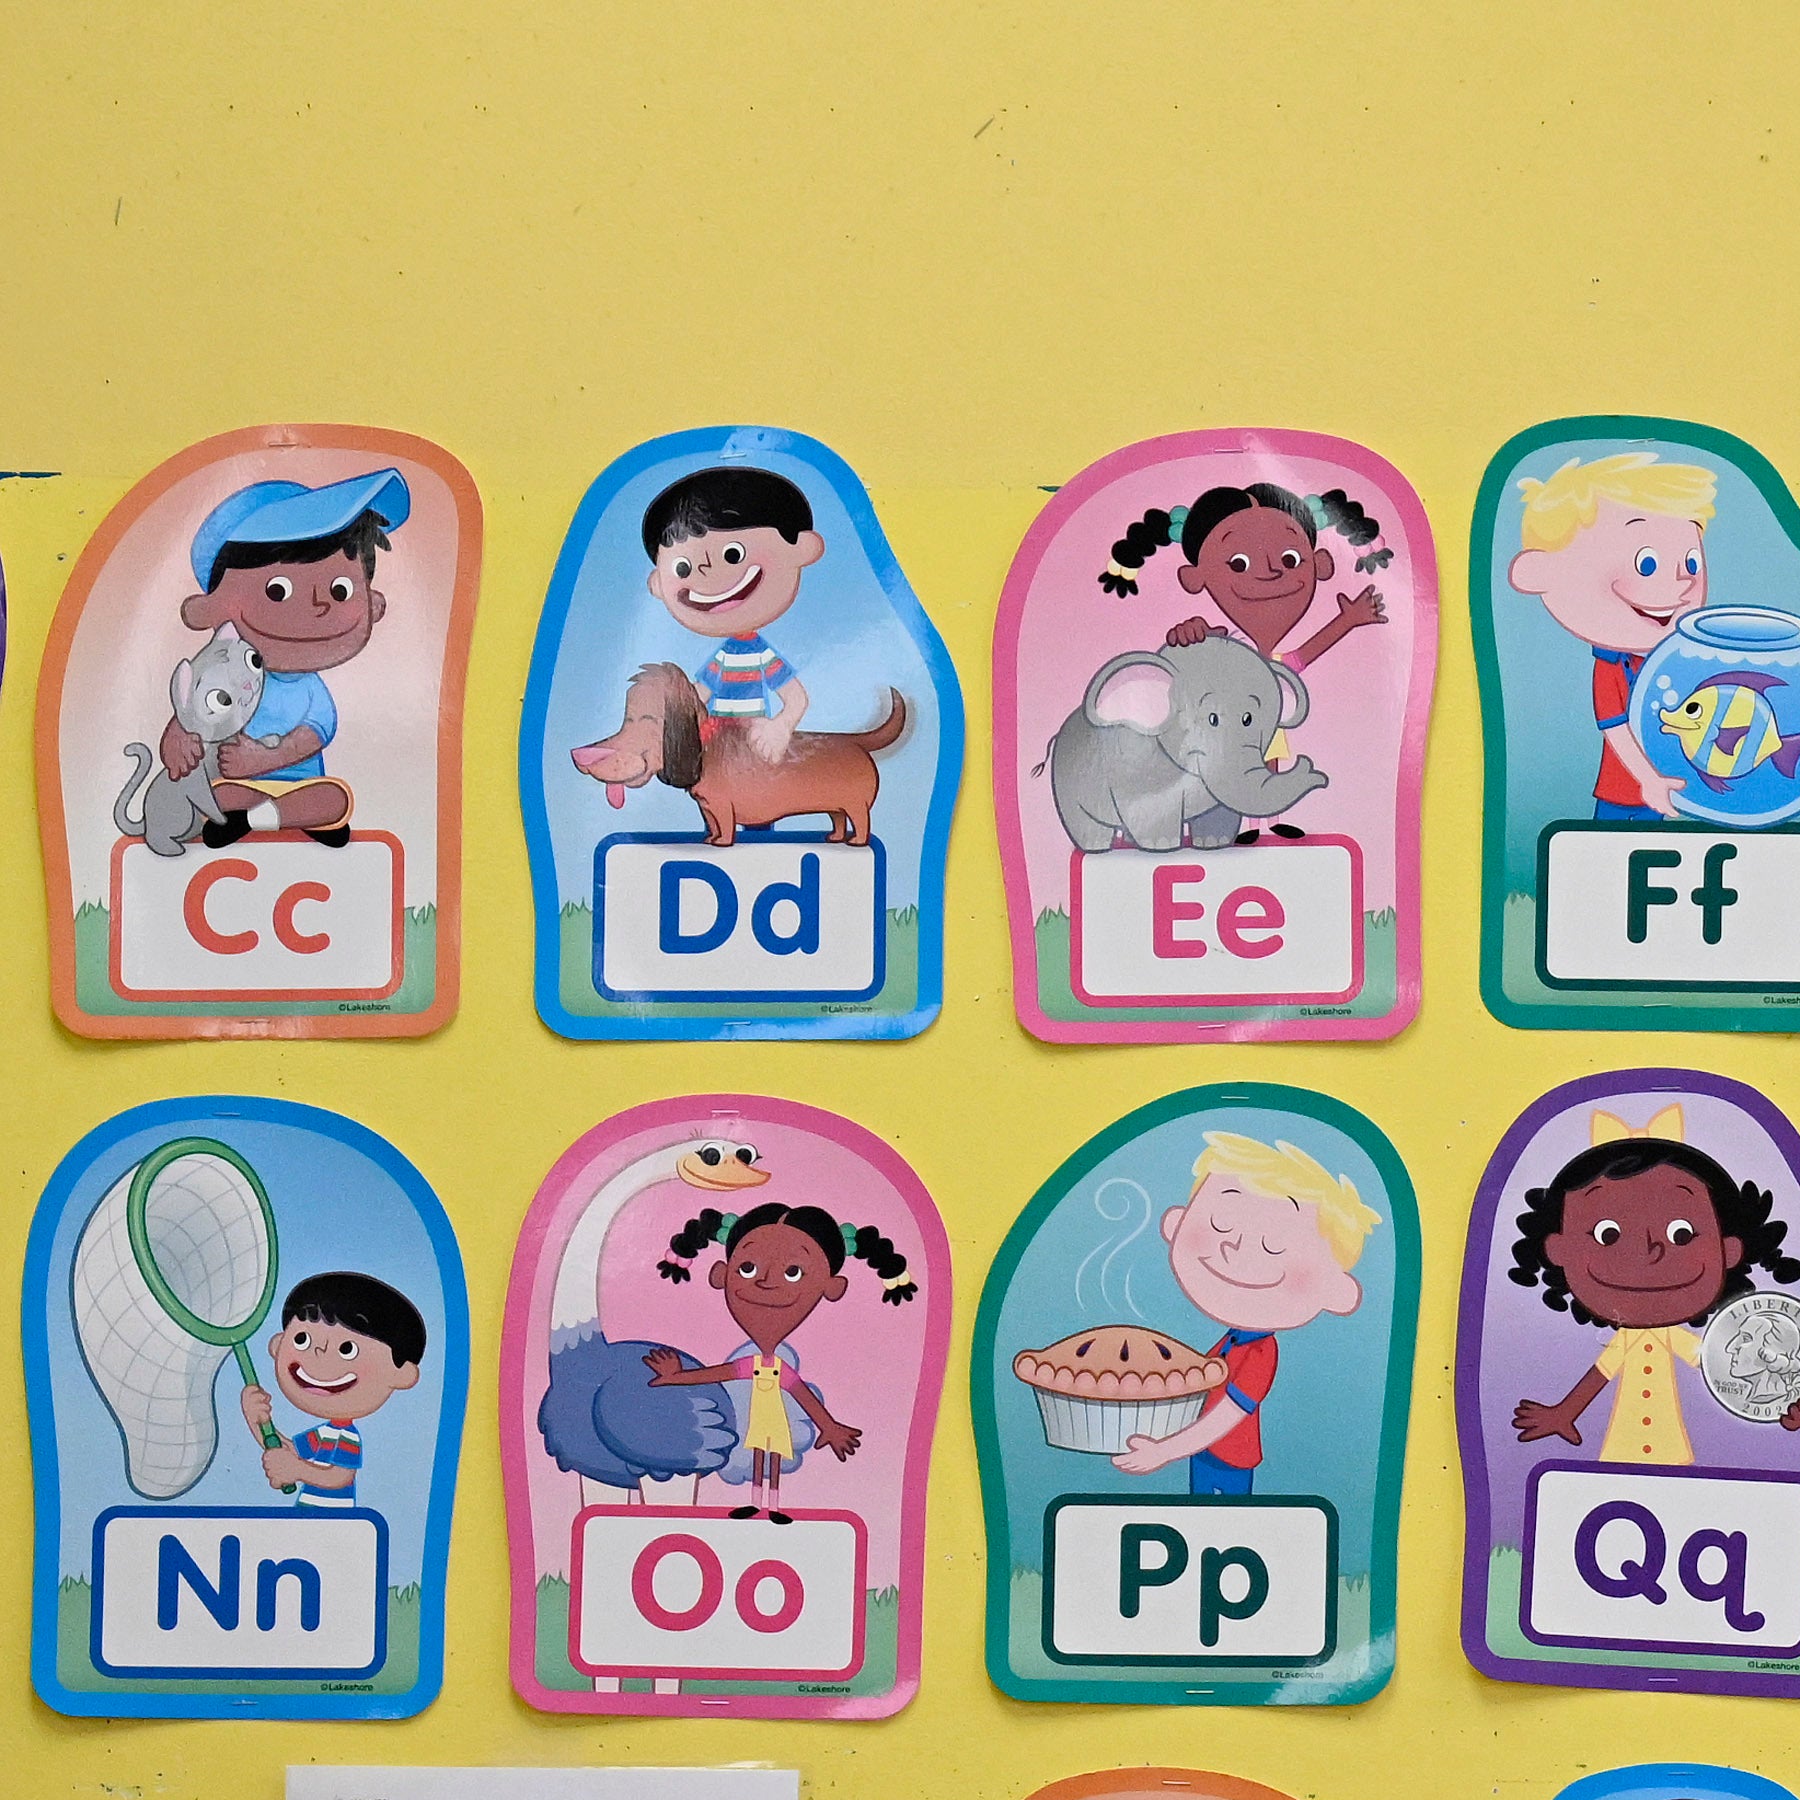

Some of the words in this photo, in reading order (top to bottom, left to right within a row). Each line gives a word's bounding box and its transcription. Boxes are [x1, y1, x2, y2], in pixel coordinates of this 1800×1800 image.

[177, 853, 330, 954] Cc
[659, 846, 820, 955] Dd
[1153, 865, 1285, 959] Ee
[1627, 843, 1738, 945] Ff
[157, 1534, 321, 1632] Nn
[632, 1534, 804, 1633] Oo
[1120, 1523, 1269, 1647] Pp
[1575, 1501, 1765, 1633] Qq
